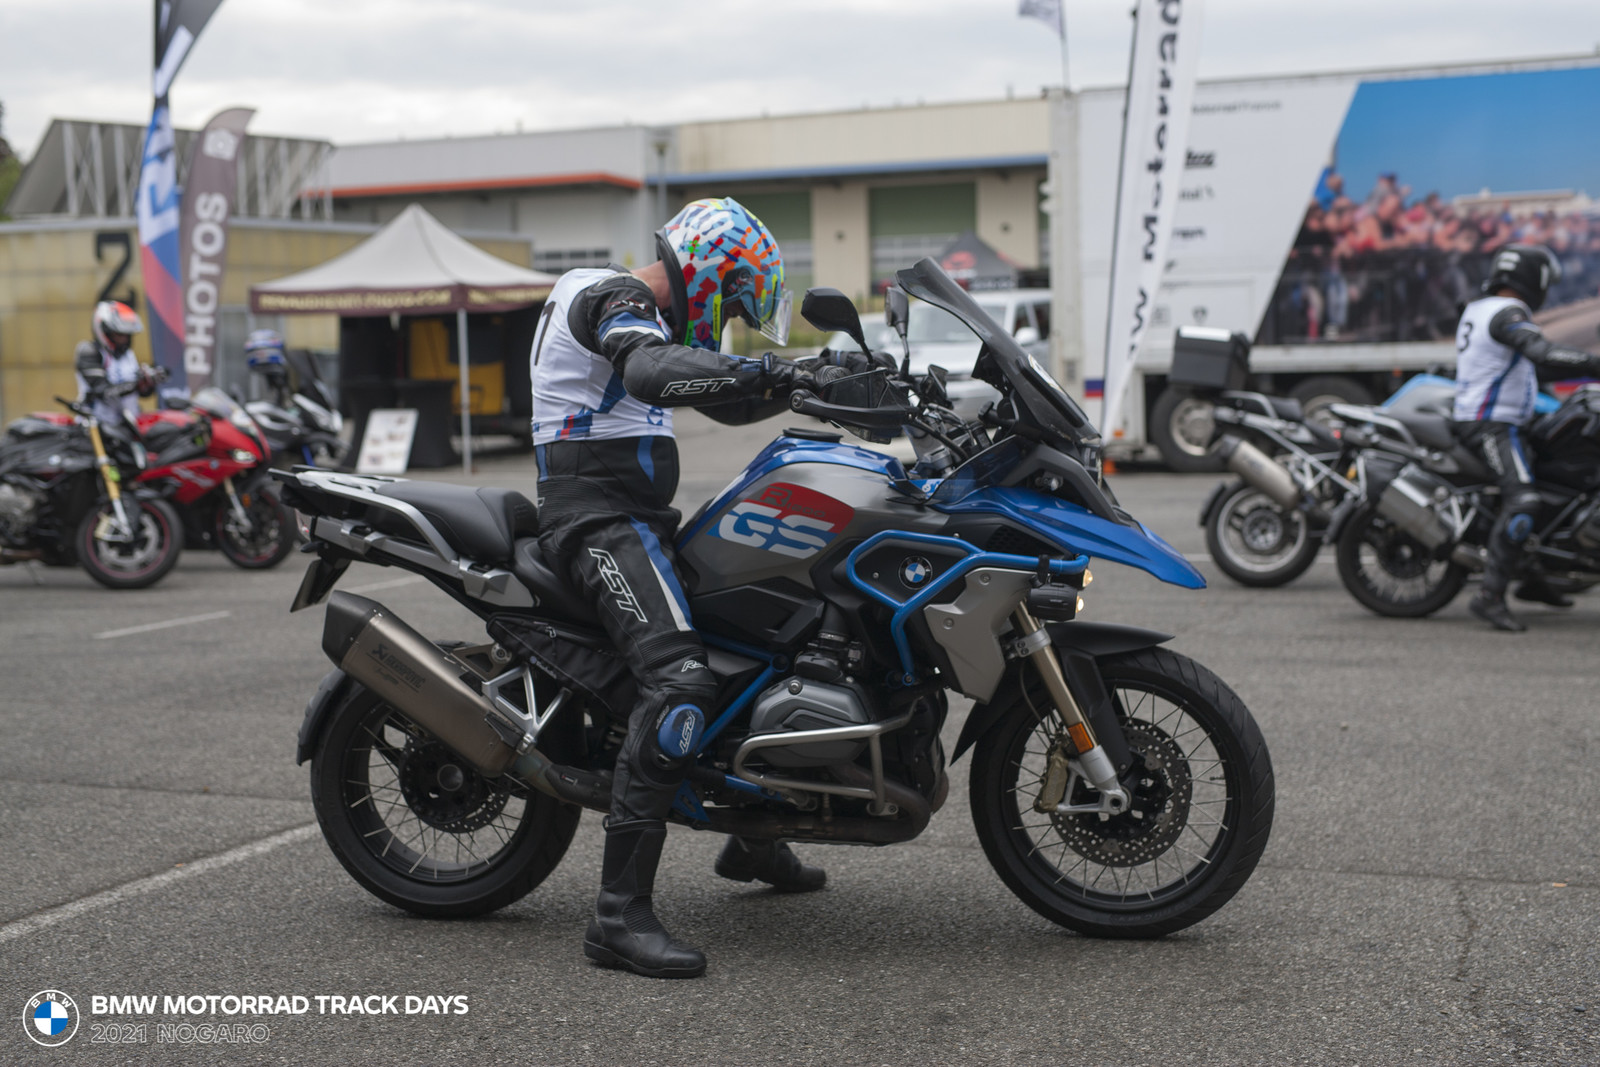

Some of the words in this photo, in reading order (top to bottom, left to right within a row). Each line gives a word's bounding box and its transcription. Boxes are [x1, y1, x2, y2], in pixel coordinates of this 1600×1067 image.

[94, 230, 135, 311] 2
[184, 192, 229, 375] PHOTOS
[660, 377, 736, 398] RST
[718, 501, 835, 560] GS
[587, 548, 648, 623] RST
[679, 710, 696, 755] RST
